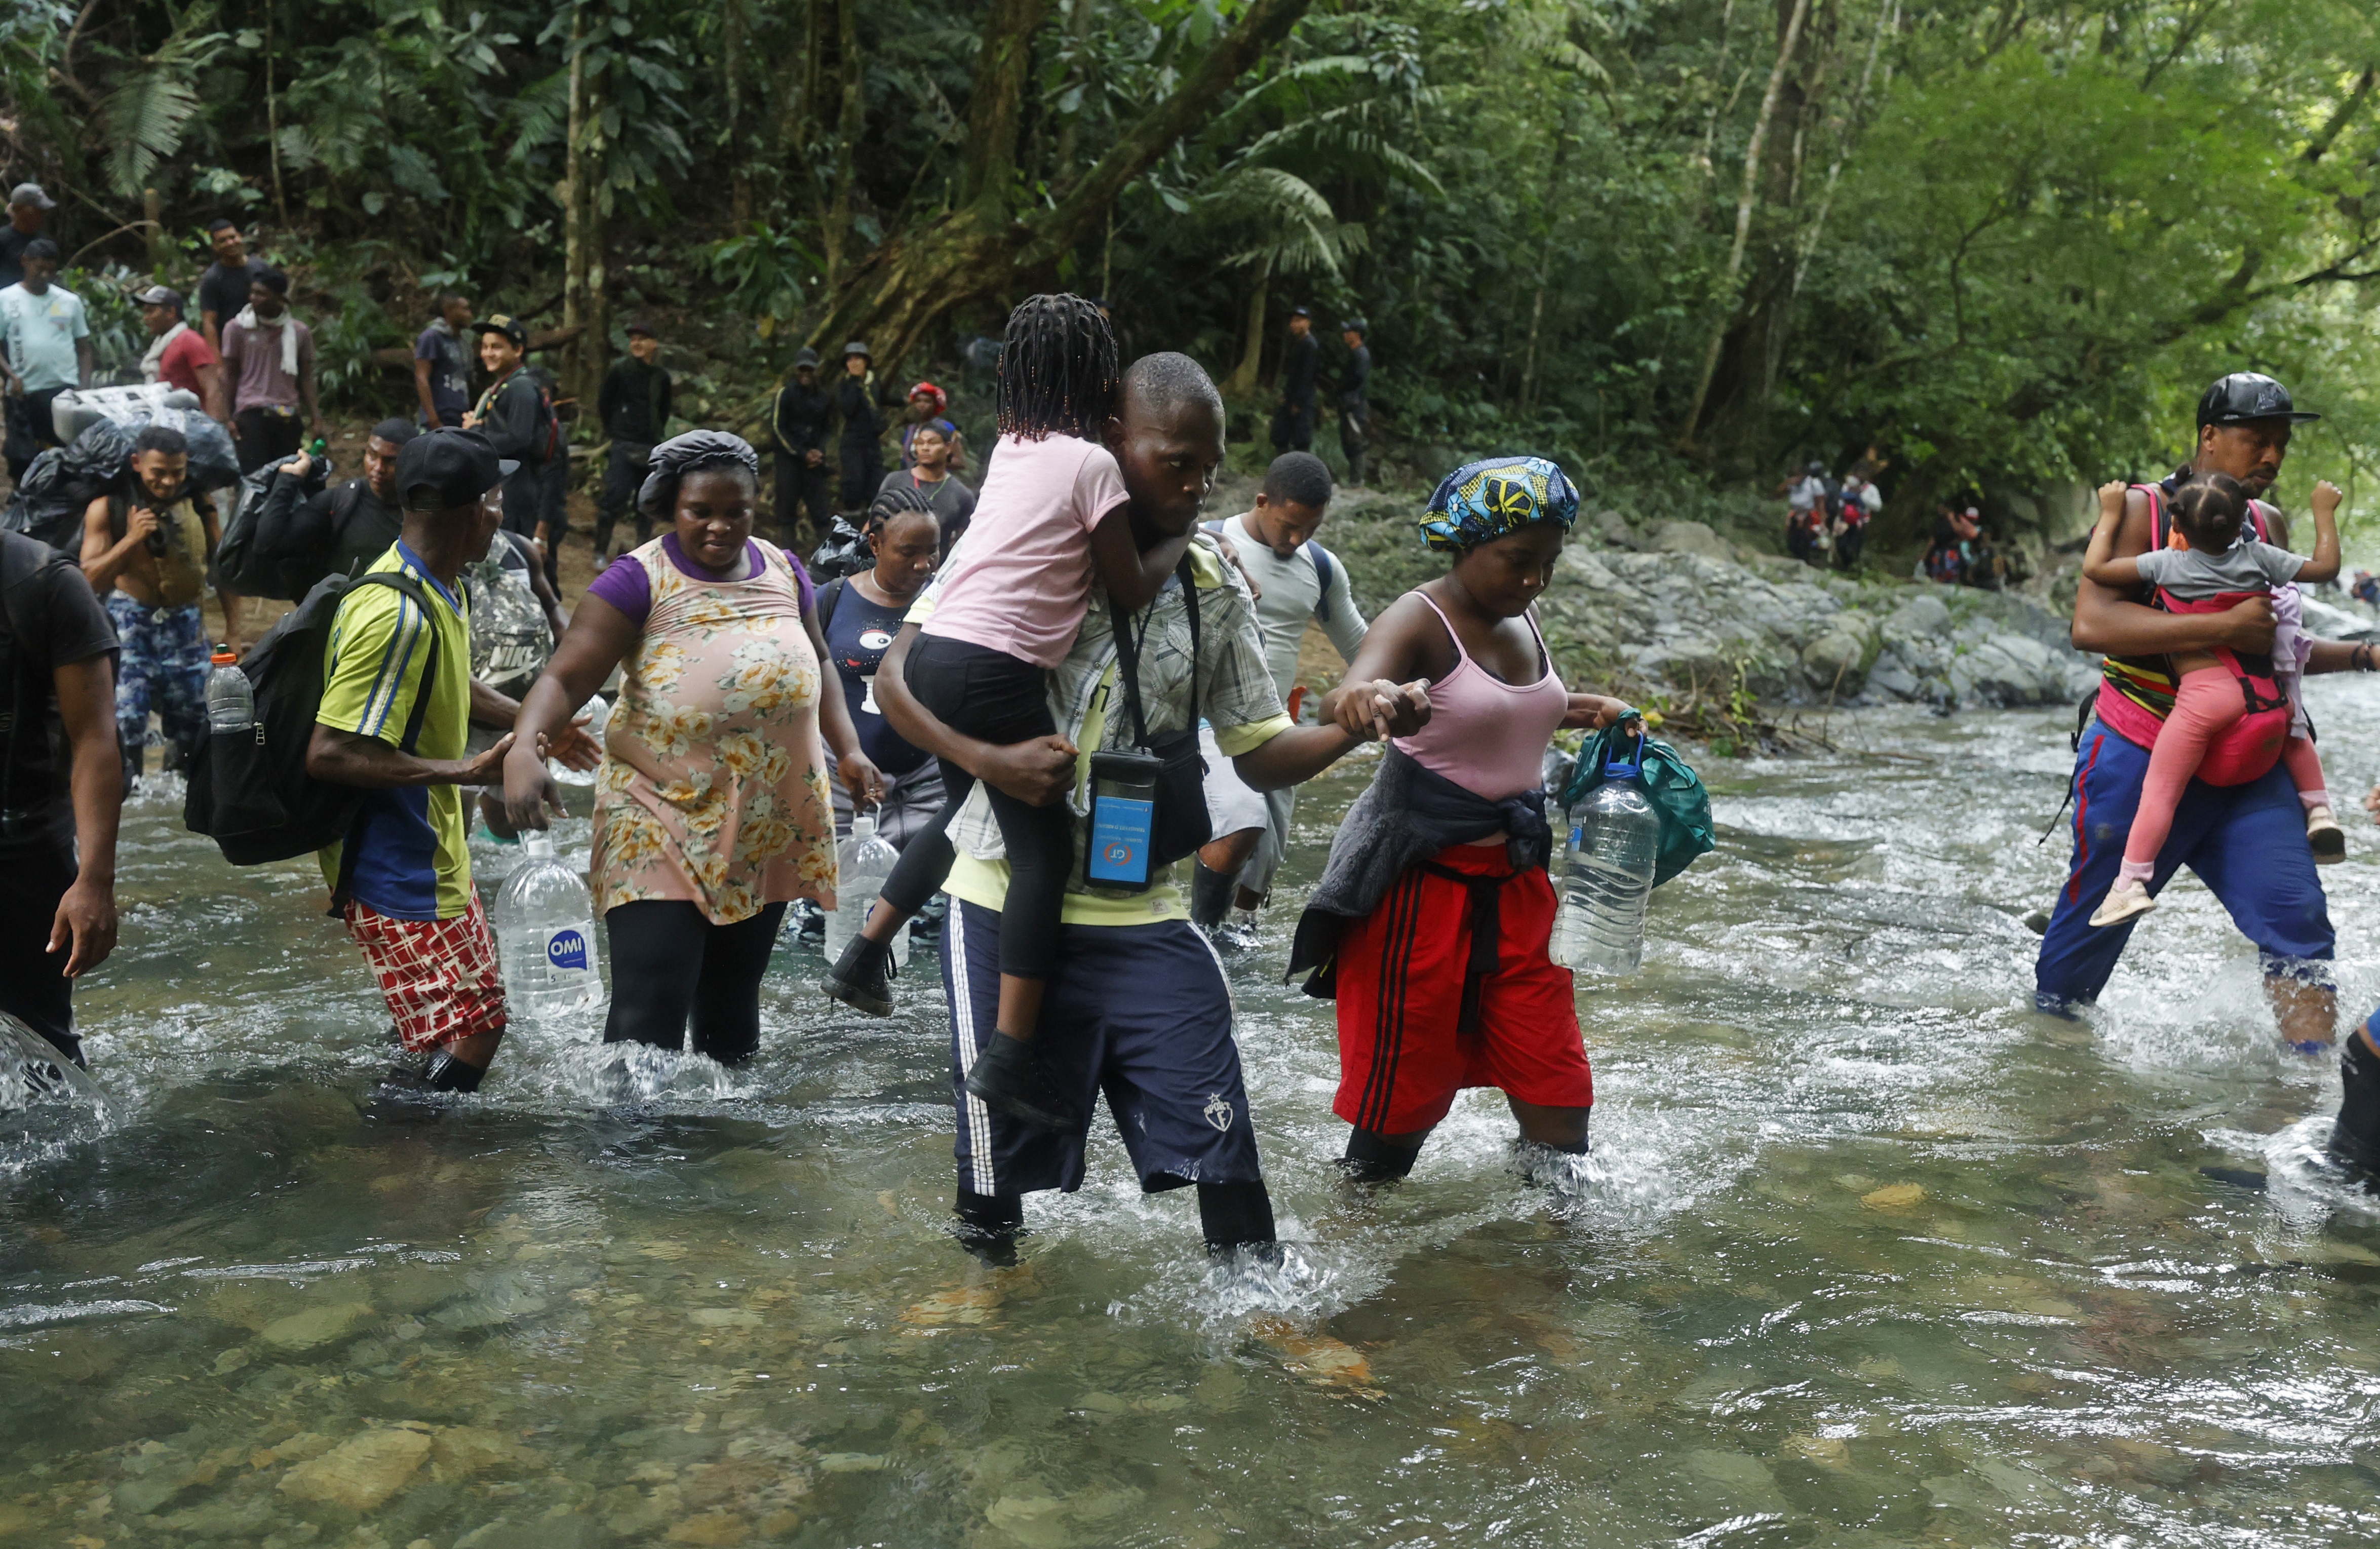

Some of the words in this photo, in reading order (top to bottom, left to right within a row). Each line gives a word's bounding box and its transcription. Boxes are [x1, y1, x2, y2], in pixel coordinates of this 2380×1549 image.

[489, 645, 535, 667] NIKE
[1110, 849, 1125, 859] GT
[551, 937, 581, 956] OMI
[1203, 1101, 1230, 1114] SPORT
[1217, 1110, 1226, 1128] F
